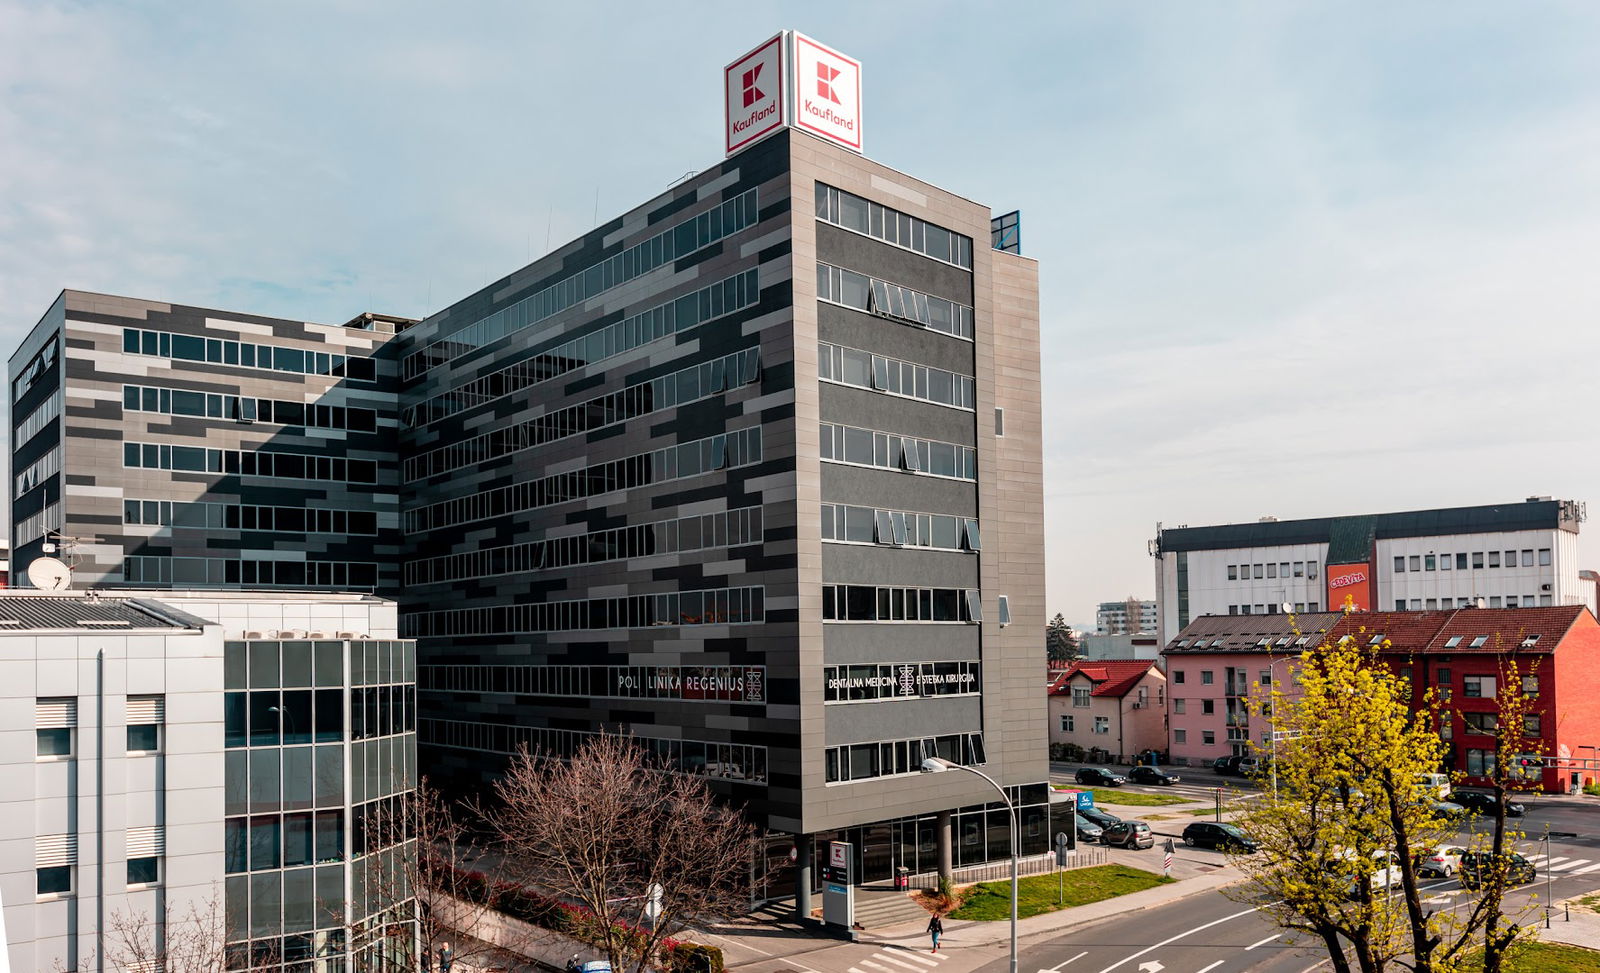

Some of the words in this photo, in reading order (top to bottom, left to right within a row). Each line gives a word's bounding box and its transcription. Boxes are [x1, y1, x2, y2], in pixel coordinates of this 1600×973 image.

[733, 99, 776, 134] Kaufland
[804, 99, 853, 130] Kaufland
[1330, 572, 1366, 588] CEDEVITA
[686, 676, 744, 691] REGENIUS
[828, 677, 864, 689] DENTALNA
[865, 676, 898, 687] MEDICINA
